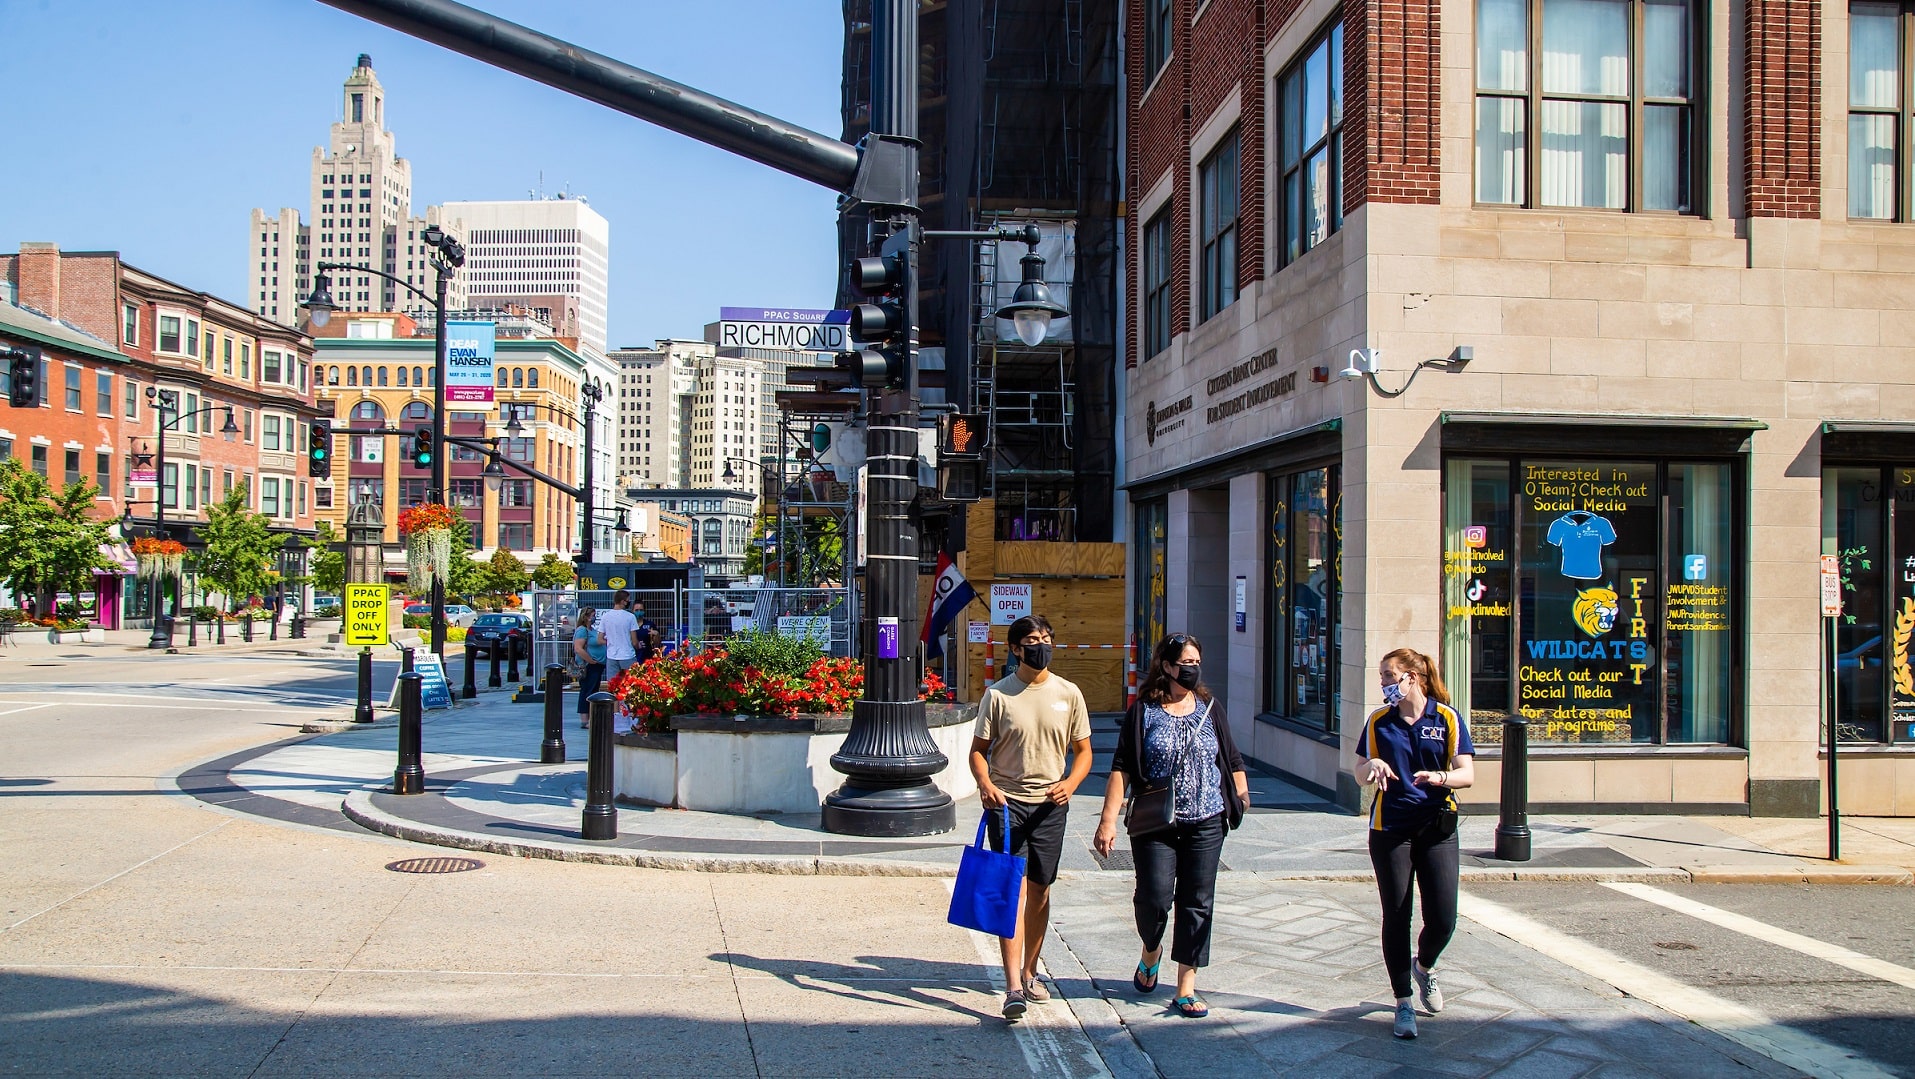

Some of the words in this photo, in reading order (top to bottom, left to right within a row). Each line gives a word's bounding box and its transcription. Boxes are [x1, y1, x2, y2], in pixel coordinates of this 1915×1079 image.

[763, 311, 790, 320] PPAC
[724, 324, 843, 347] RICHMOND
[449, 339, 479, 349] DEAR
[450, 348, 477, 357] EVAN
[449, 357, 492, 366] HANSEN
[1207, 371, 1232, 396] CITIZENS
[1232, 361, 1250, 385] BANK
[1250, 348, 1278, 375] CENTER
[1207, 407, 1218, 425] FOR
[1218, 393, 1246, 420] STUDENT
[1246, 371, 1297, 408] INVOLVEMENT
[1526, 465, 1600, 481] Interested
[1612, 468, 1628, 481] in
[1525, 482, 1536, 496] O
[1538, 482, 1577, 497] Team?
[1579, 482, 1622, 497] Check
[1626, 483, 1648, 497] out
[1533, 497, 1575, 511] Social
[1583, 498, 1627, 512] Media
[1825, 576, 1836, 588] BUS
[353, 589, 381, 597] PPAC
[993, 586, 1028, 596] SIDEWALK
[1667, 585, 1728, 595] JWUPVDStudent
[1667, 595, 1719, 606] Involvement
[1825, 591, 1837, 601] STOP
[352, 600, 383, 608] DROP
[998, 600, 1024, 610] OPEN
[357, 611, 377, 620] OFF
[352, 622, 382, 631] ONLY
[1630, 577, 1647, 685] FIRST
[1526, 640, 1647, 659] WILDCATS
[1519, 665, 1563, 682] Check
[1568, 668, 1592, 682] out
[1599, 671, 1624, 682] our
[1522, 684, 1566, 699] Social
[1574, 684, 1613, 699] Media
[1519, 704, 1545, 719] for
[1552, 704, 1597, 719] dates
[1605, 703, 1632, 719] and
[1547, 720, 1616, 737] programs
